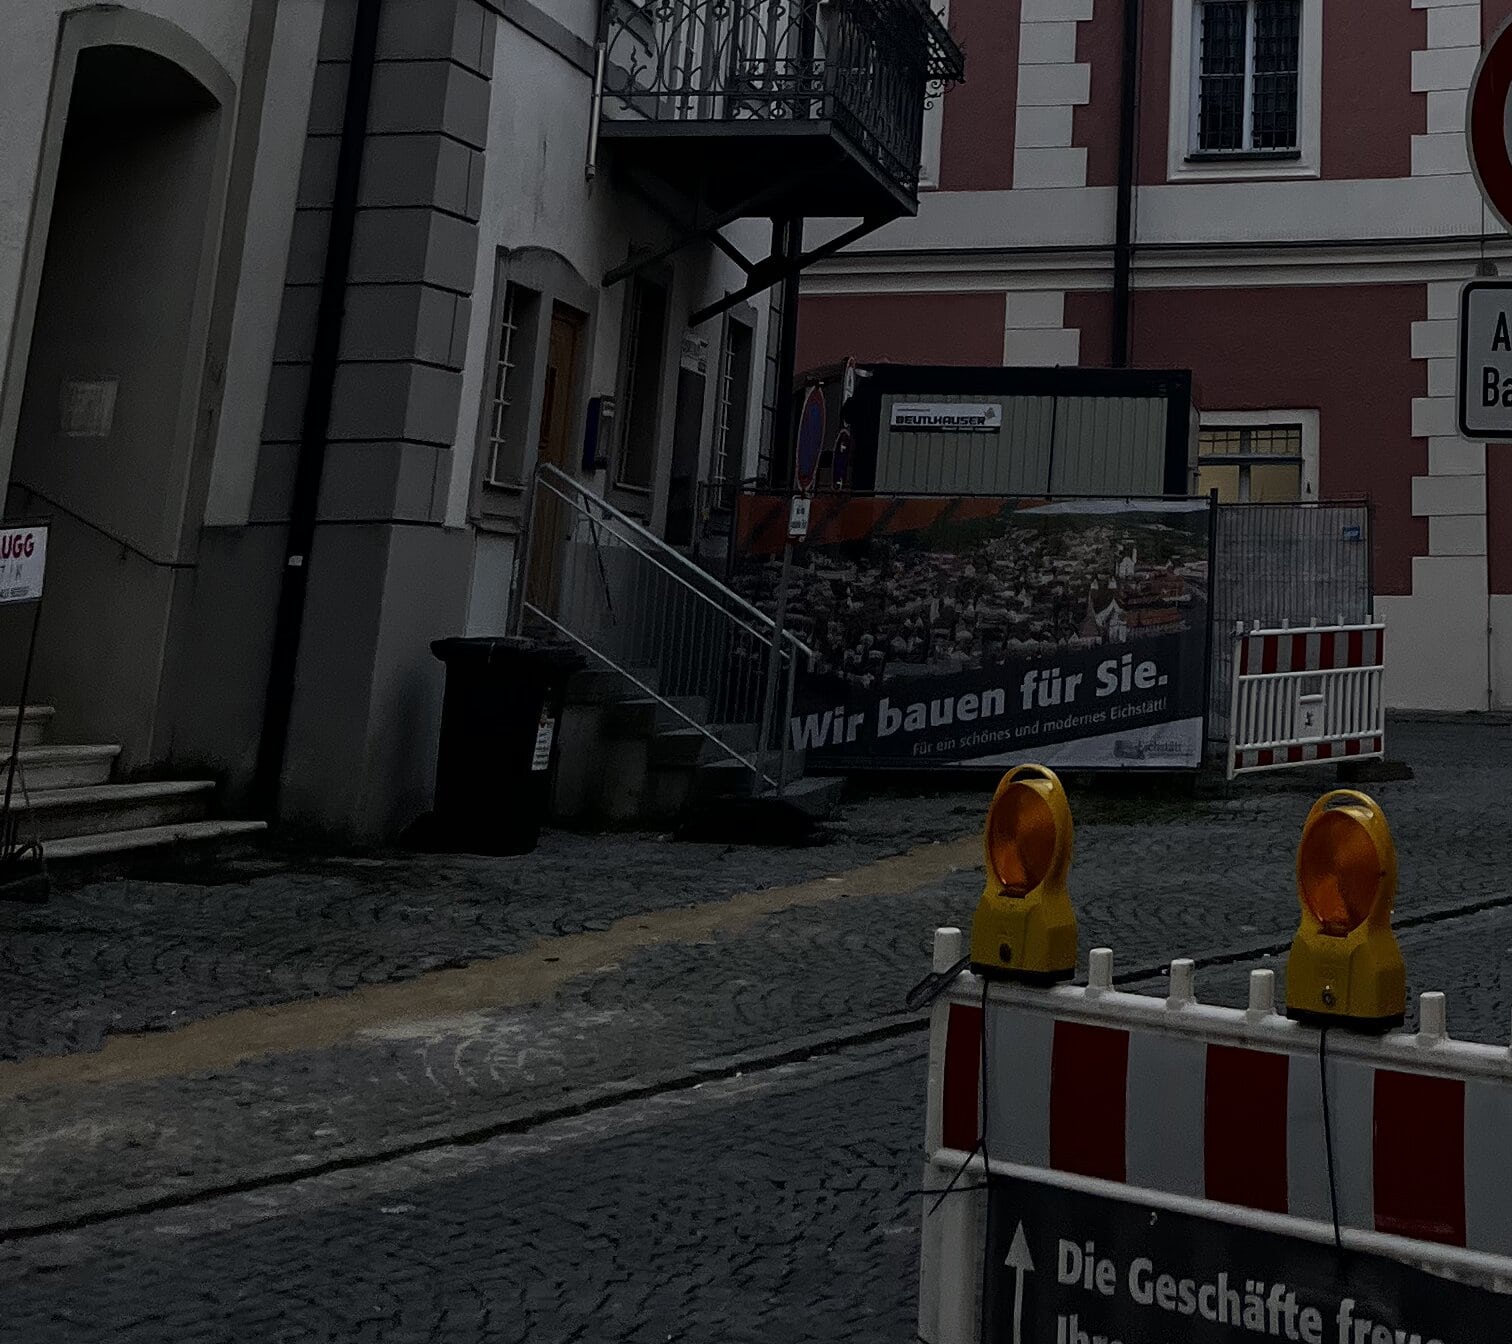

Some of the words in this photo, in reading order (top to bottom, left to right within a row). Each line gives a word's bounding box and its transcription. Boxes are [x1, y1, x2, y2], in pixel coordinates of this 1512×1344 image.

[0, 533, 34, 559] UGG
[791, 706, 865, 752] Wir
[876, 688, 1006, 738] bauen
[1020, 667, 1084, 710] für
[1095, 653, 1169, 697] Sie.
[912, 741, 934, 756] für
[936, 739, 956, 752] ein
[960, 729, 1011, 748] schönes
[1015, 720, 1040, 737] und
[1043, 711, 1107, 732] modernes
[1056, 1238, 1116, 1296] Die
[1127, 1258, 1322, 1344] Geschäfte
